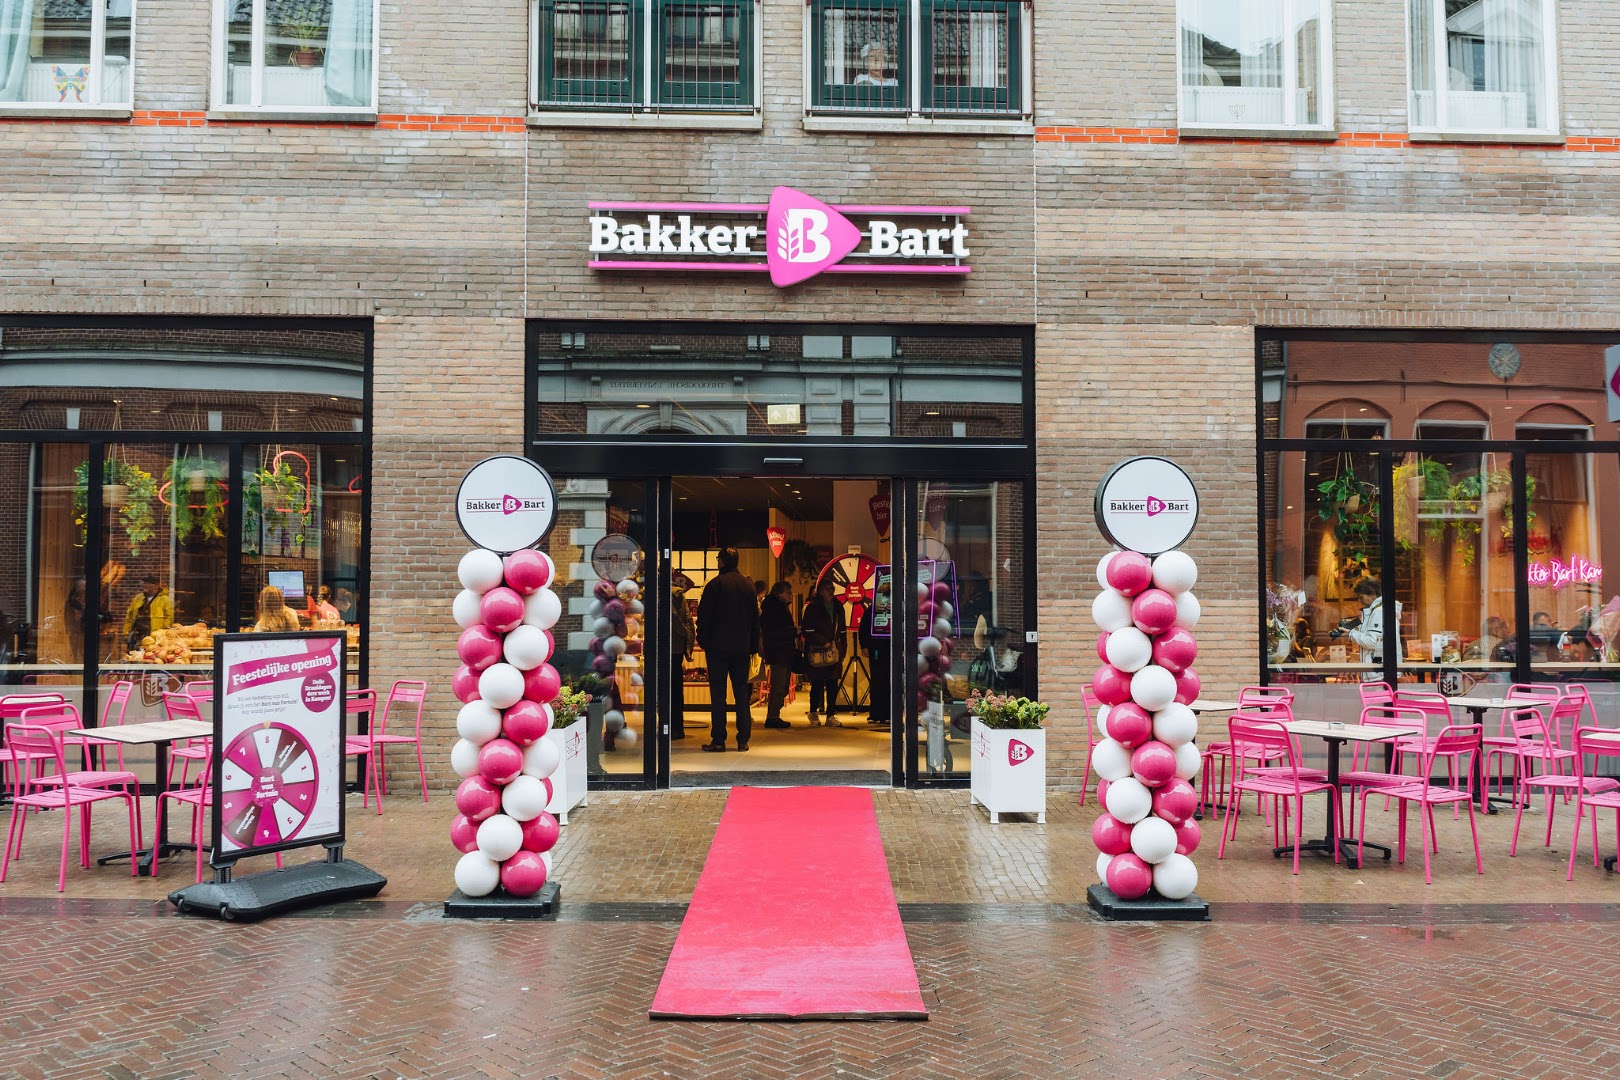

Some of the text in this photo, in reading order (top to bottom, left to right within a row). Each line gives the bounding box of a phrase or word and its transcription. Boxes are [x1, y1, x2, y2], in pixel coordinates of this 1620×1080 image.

[588, 208, 971, 263] Bakker B Bart
[466, 501, 501, 510] Bakker
[523, 500, 546, 509] Bart
[1110, 502, 1145, 511] Bakker
[1167, 502, 1190, 511] Bart
[1528, 562, 1550, 583] kker
[1550, 555, 1576, 587] Bart
[231, 654, 332, 686] Feestelijke opening
[240, 747, 246, 756] 7
[1011, 744, 1028, 761] B
[287, 817, 293, 825] 3
